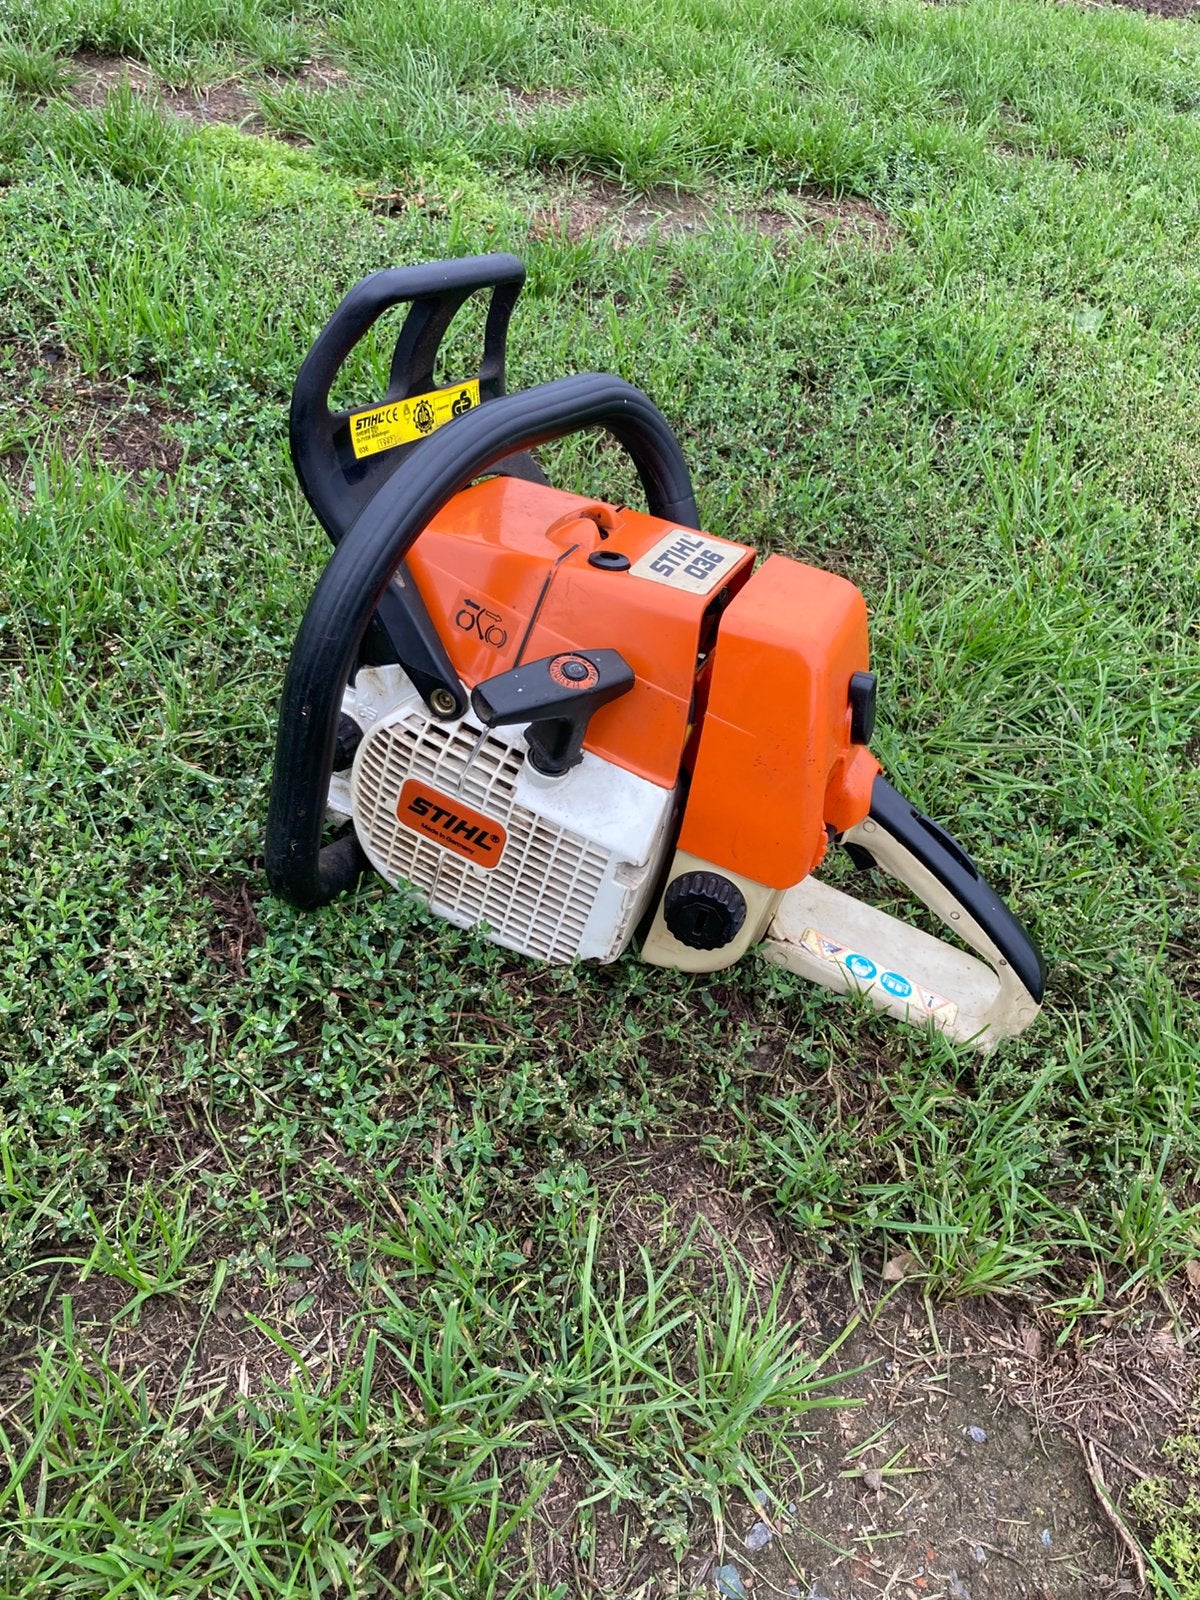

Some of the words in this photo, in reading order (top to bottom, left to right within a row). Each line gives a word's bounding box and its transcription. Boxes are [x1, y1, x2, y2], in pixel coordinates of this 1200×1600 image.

[649, 538, 704, 577] STIHL
[683, 549, 725, 580] 036
[421, 822, 439, 836] Made
[446, 836, 475, 854] Germany
